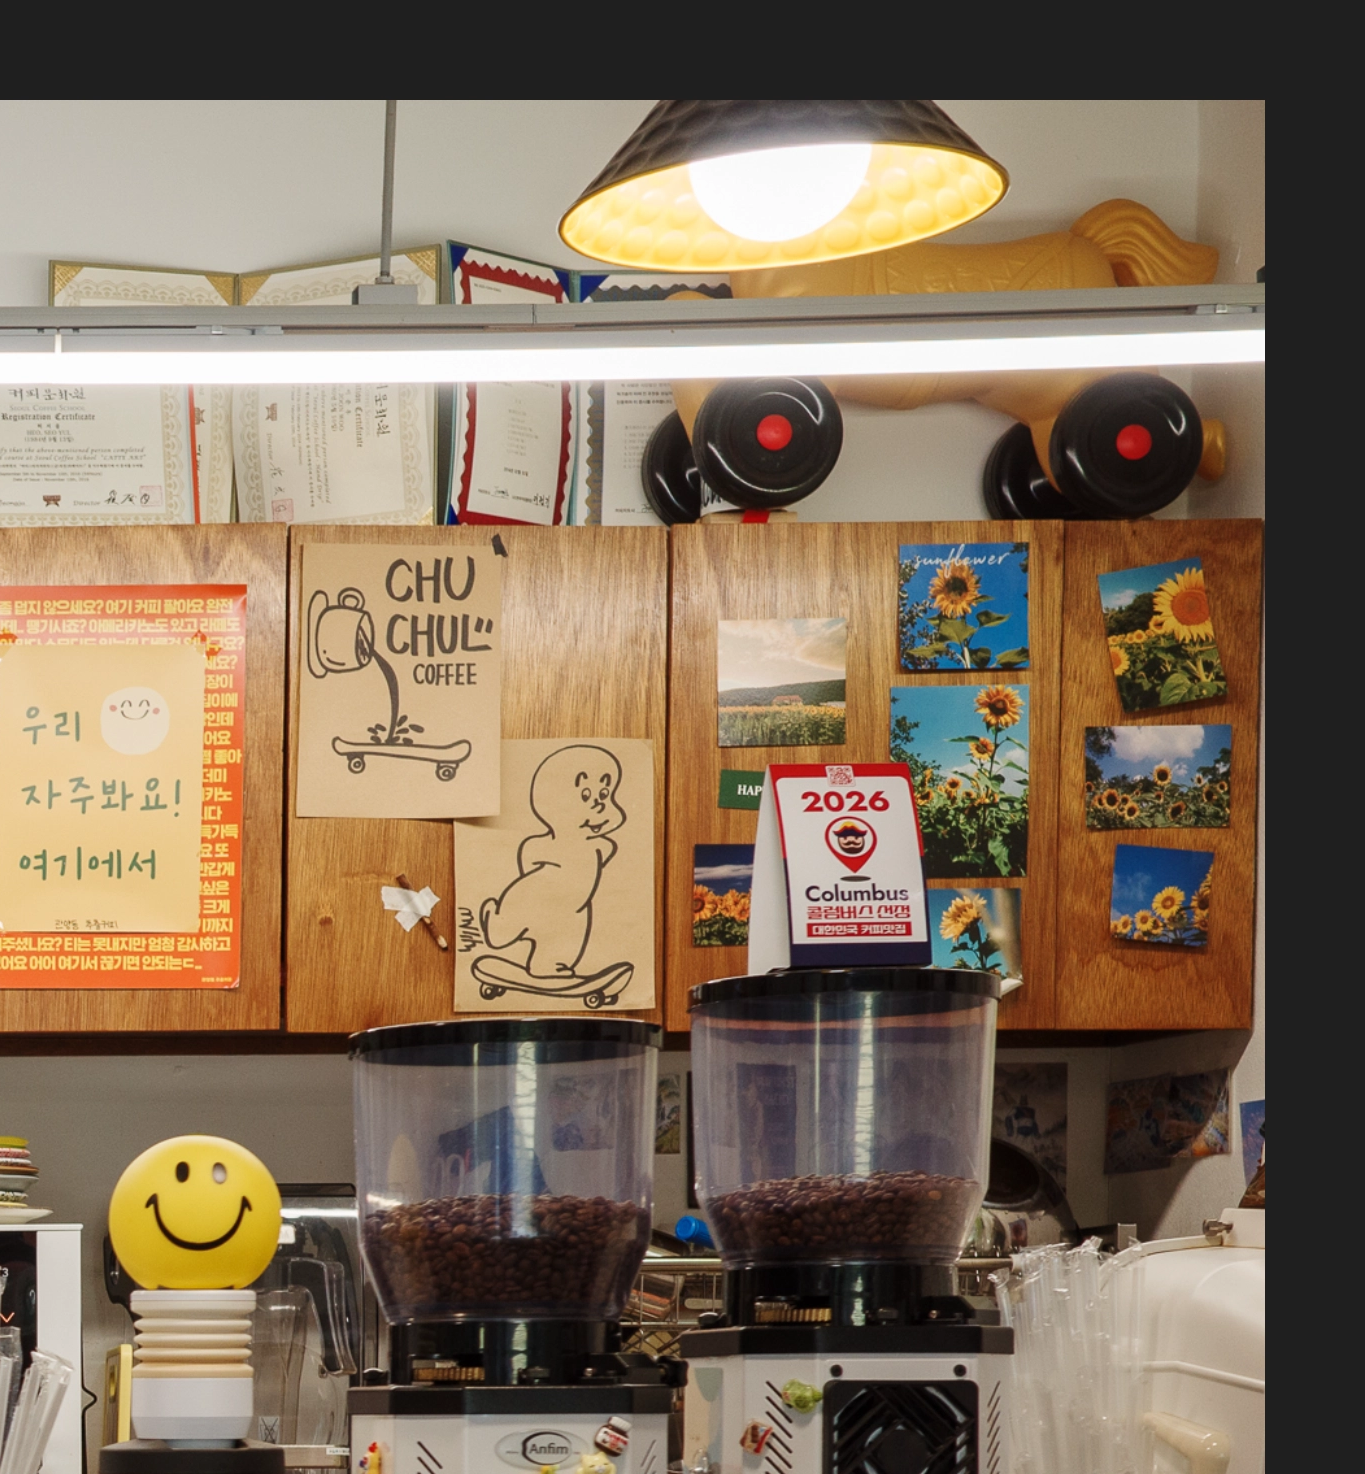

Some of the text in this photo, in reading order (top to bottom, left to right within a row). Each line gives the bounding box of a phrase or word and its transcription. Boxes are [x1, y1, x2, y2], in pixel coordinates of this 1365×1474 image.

[1, 412, 96, 422] Registration Certificate
[914, 546, 1010, 577] sunflower
[385, 556, 476, 604] CHU
[14, 600, 40, 615] 덥지
[42, 599, 104, 615] 않으세요?
[105, 600, 133, 615] 여기
[134, 599, 162, 615] 커피
[163, 598, 205, 614] 팔아요
[206, 598, 234, 614] 완전
[89, 617, 169, 633] 아메리카노도
[171, 617, 199, 633] 있고
[412, 661, 478, 687] COFFEE
[21, 705, 81, 745] 우리
[21, 775, 181, 818] 자주봐요!
[800, 790, 891, 813] 2026
[19, 847, 158, 881] 여기에서
[805, 882, 910, 903] Columbus
[807, 905, 875, 920] 콜럼버스
[812, 922, 907, 936] 대한민국 커피맛집
[93, 937, 147, 952] 못내지만
[148, 936, 175, 952] 엄청
[177, 936, 231, 952] 감사하고
[29, 955, 57, 971] 어어
[58, 955, 98, 971] 여기서
[99, 955, 140, 971] 끊기면
[527, 1443, 570, 1456] Anfim
